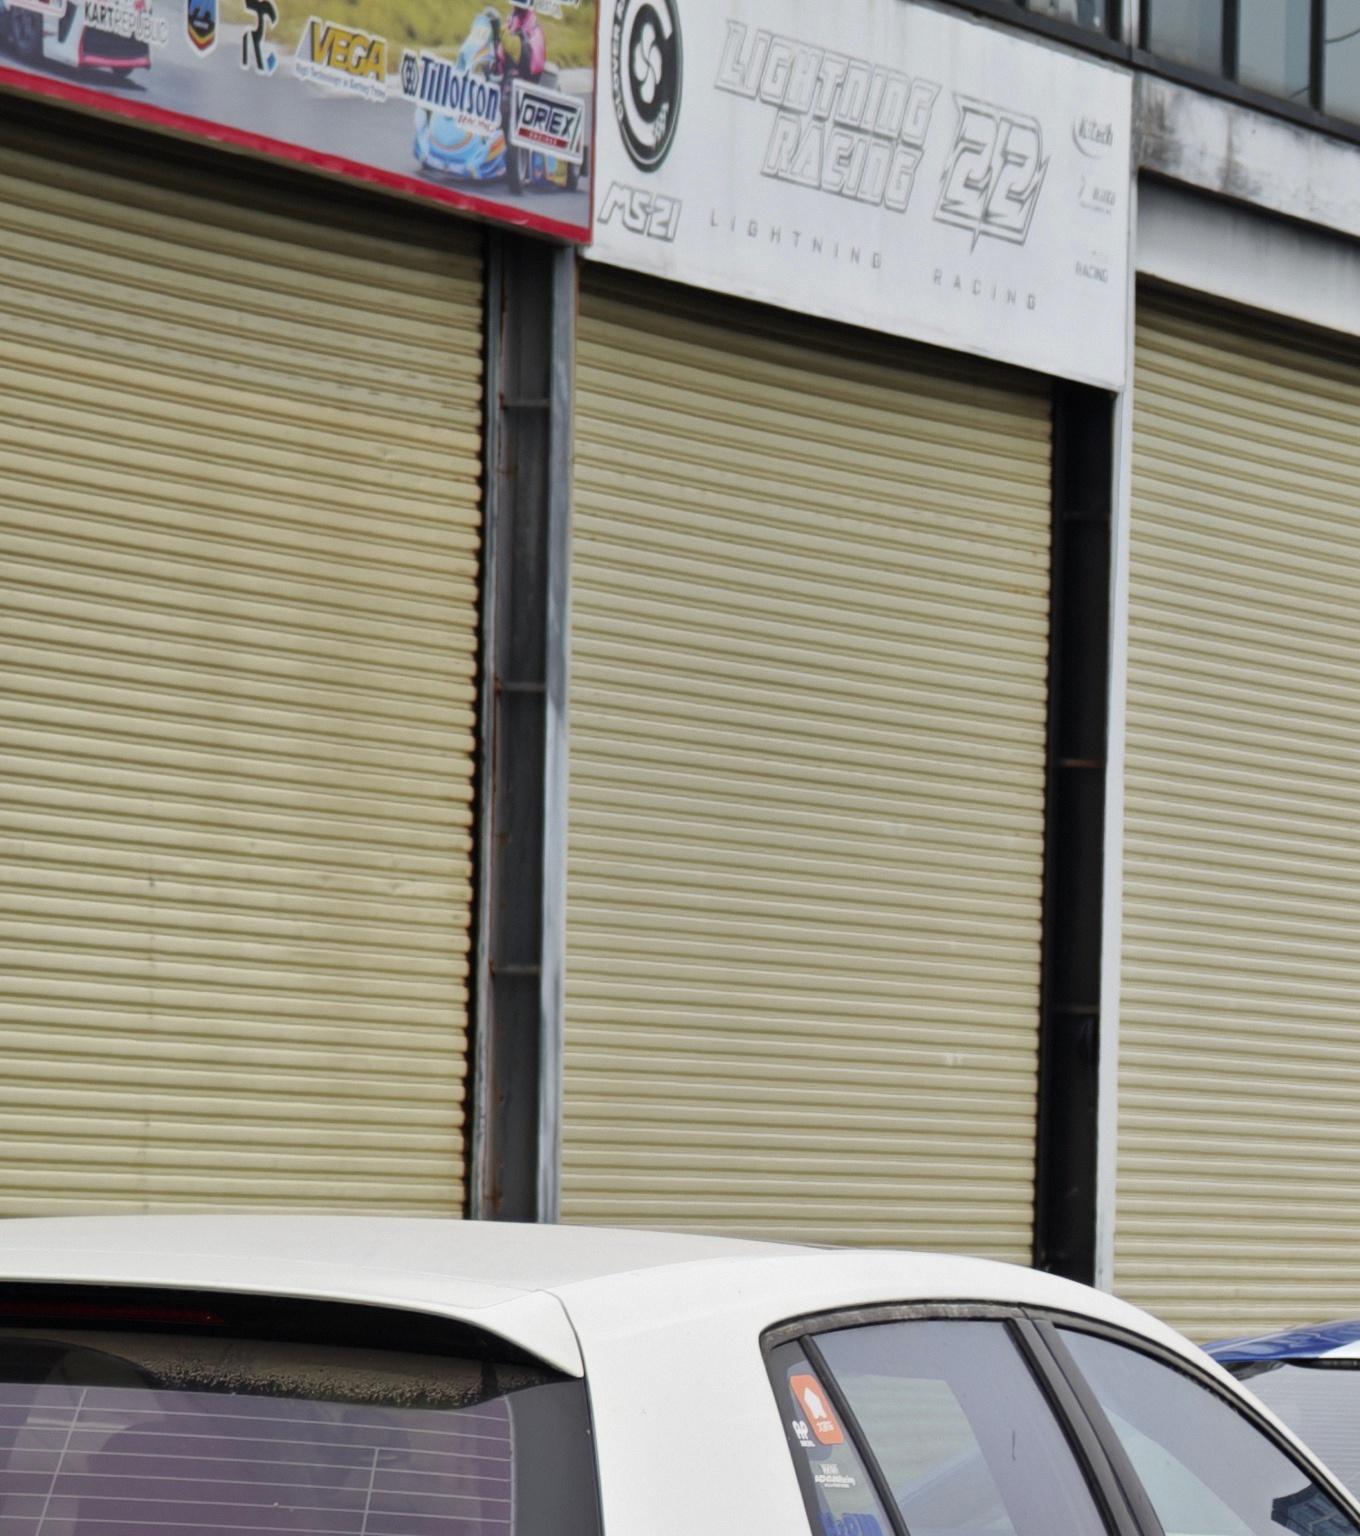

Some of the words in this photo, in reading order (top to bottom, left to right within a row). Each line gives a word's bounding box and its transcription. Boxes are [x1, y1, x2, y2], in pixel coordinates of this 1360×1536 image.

[309, 20, 386, 81] VEGA
[419, 56, 499, 122] Tillotson
[714, 19, 941, 145] LIGHTNING
[514, 90, 577, 139] VORTEX
[760, 110, 924, 212] RACING
[709, 210, 884, 270] LIGHTNING
[933, 268, 1037, 311] RACING
